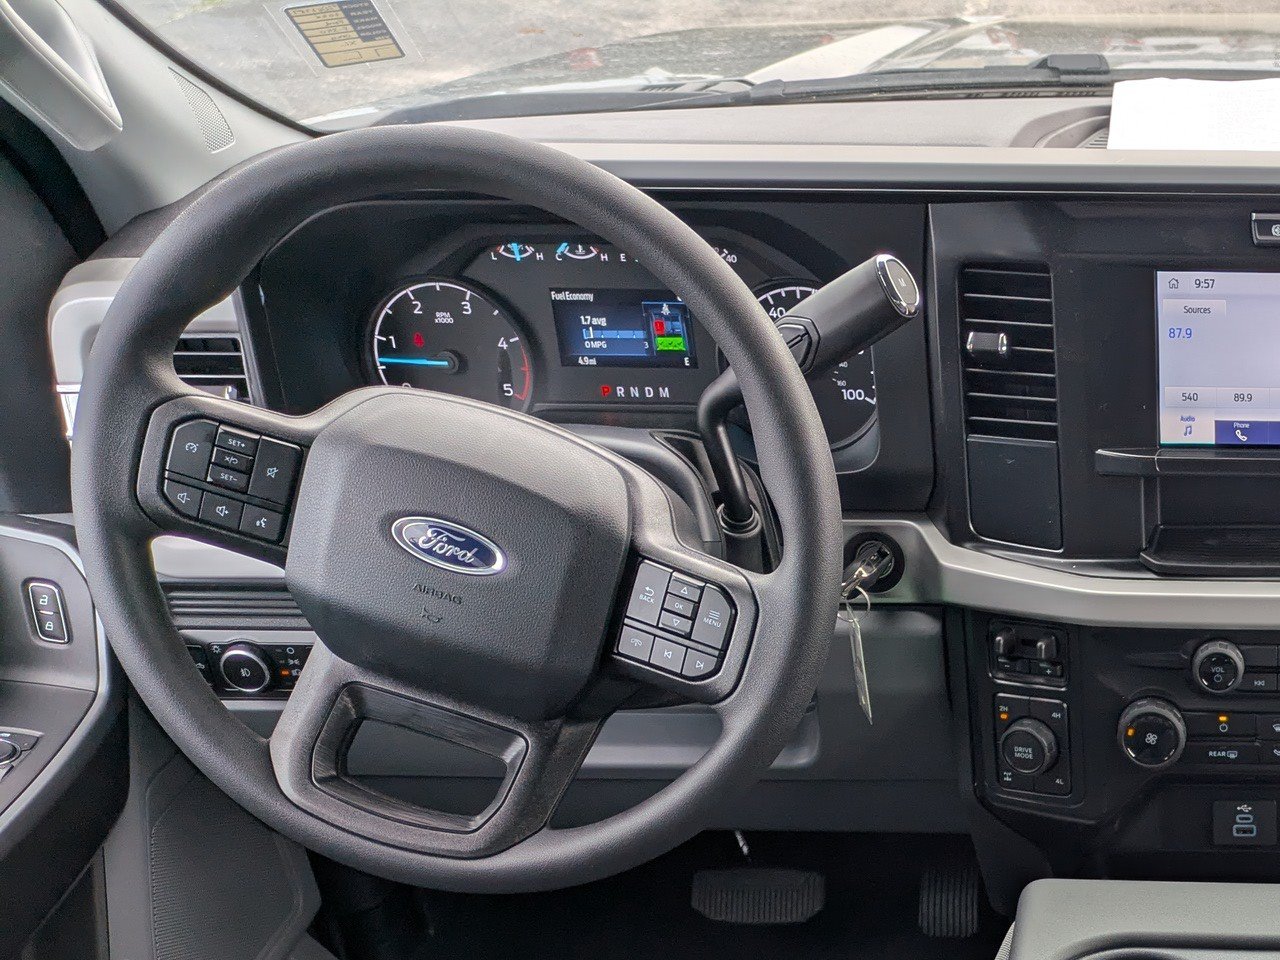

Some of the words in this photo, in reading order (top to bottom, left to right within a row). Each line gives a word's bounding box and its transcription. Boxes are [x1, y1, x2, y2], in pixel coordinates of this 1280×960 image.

[491, 252, 498, 260] L
[536, 252, 544, 261] H
[600, 253, 609, 261] H
[620, 253, 626, 262] E
[726, 254, 738, 263] 40
[1194, 278, 1216, 289] 9:57
[550, 291, 565, 300] Fuel
[565, 292, 594, 302] Economy
[413, 301, 423, 314] 2
[461, 302, 472, 315] 3
[1183, 305, 1212, 314] Sources
[580, 315, 591, 325] 1.7
[591, 317, 607, 326] avg
[1168, 327, 1192, 339] 87.9
[388, 336, 396, 348] 1
[497, 336, 508, 350] 4
[644, 341, 649, 349] 3
[684, 357, 690, 366] E
[503, 383, 513, 396] 5
[601, 385, 611, 397] P
[616, 387, 625, 398] R
[630, 387, 639, 398] N
[645, 388, 654, 398] D
[659, 388, 669, 398] M
[841, 389, 865, 400] 100
[1181, 392, 1199, 402] 540
[1233, 393, 1253, 403] 89.9
[417, 527, 478, 563] Ford
[638, 594, 655, 604] BACK
[674, 602, 684, 610] OK
[702, 617, 722, 628] MENU
